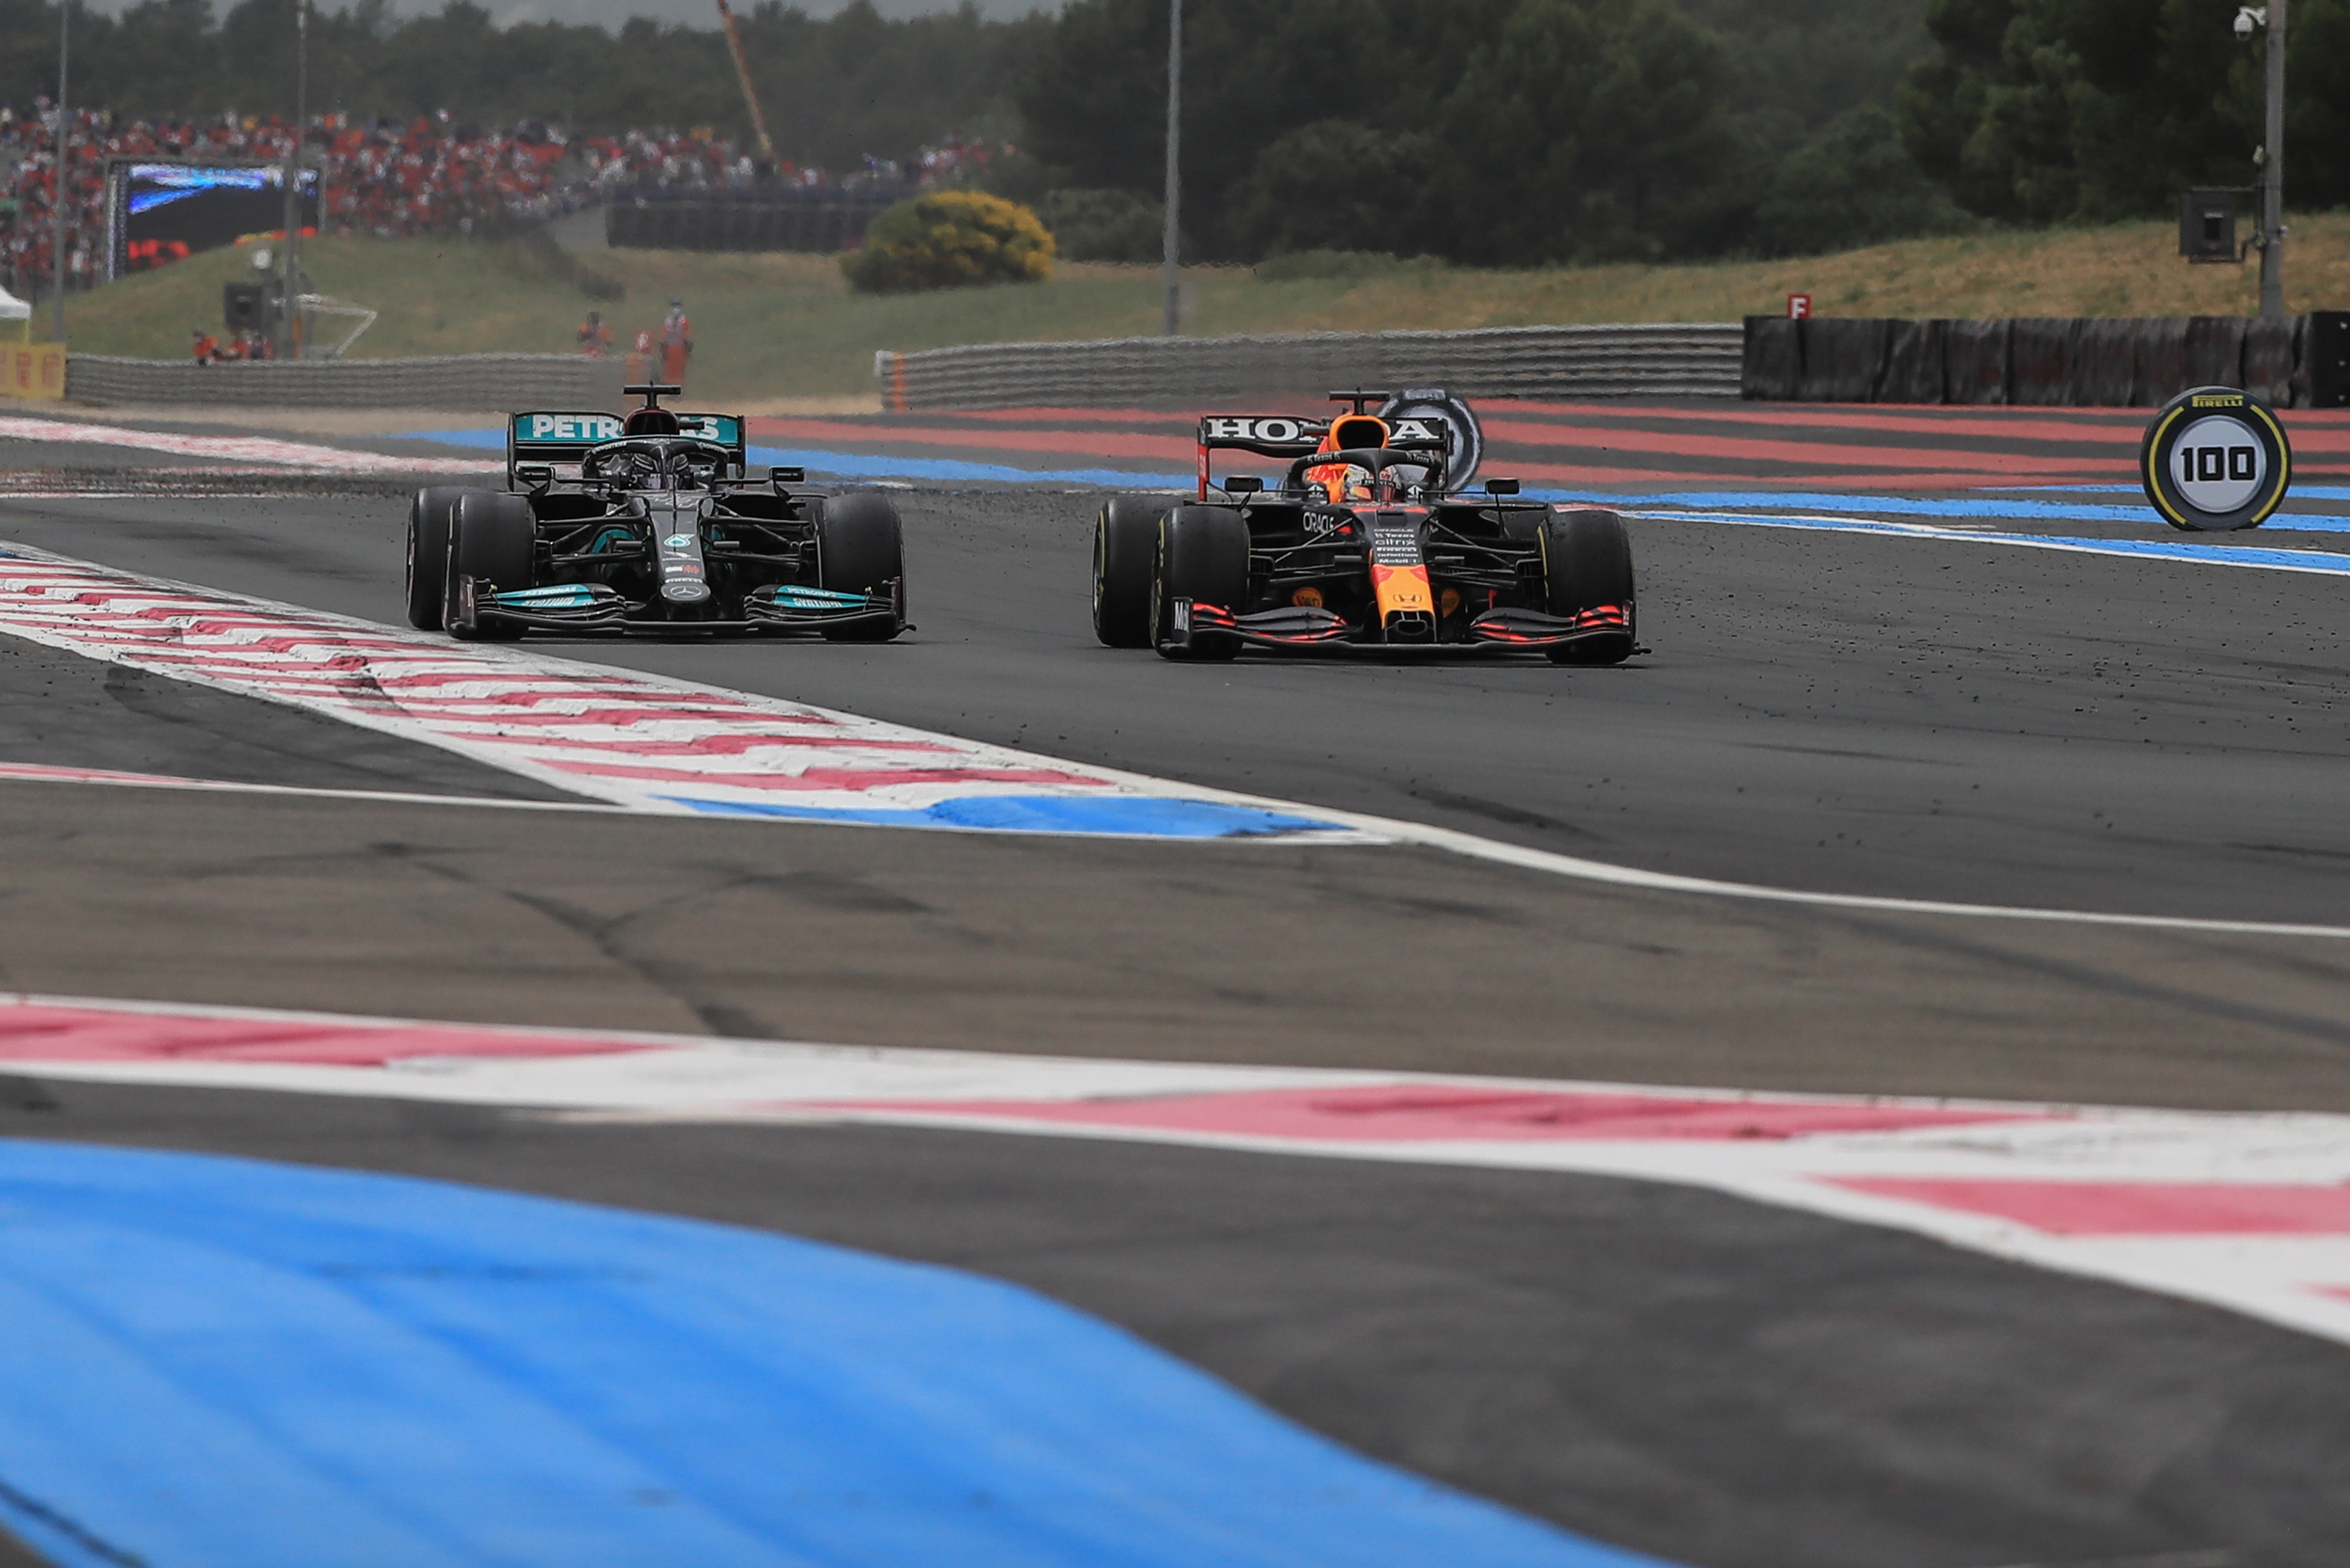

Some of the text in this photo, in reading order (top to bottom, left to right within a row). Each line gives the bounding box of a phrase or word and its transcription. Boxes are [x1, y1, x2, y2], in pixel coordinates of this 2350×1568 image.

[1791, 298, 1806, 319] F
[2192, 395, 2243, 407] PIRELLI
[533, 415, 719, 439] PETRAS
[2180, 446, 2255, 482] 100
[525, 586, 577, 595] PETRONAS
